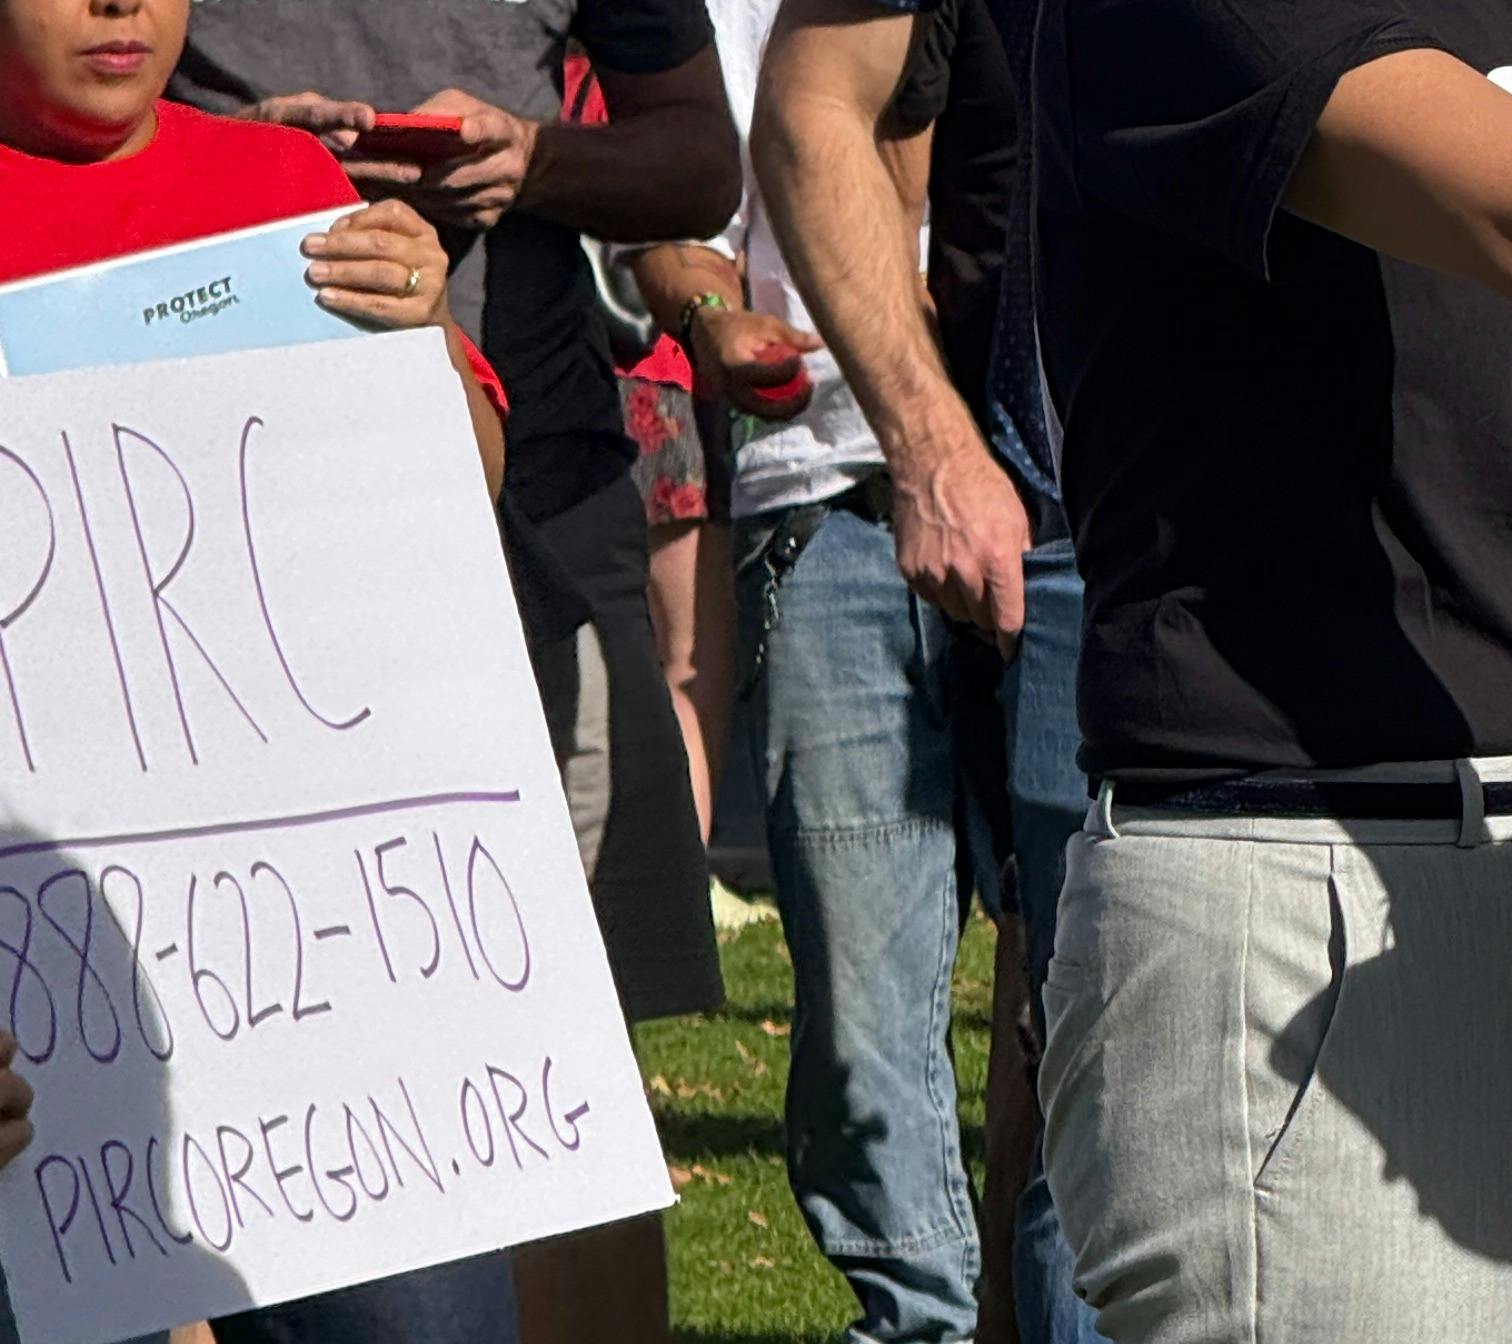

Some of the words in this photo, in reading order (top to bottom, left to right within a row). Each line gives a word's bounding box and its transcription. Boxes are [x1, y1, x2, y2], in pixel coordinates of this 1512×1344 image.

[142, 275, 232, 326] PROTECT
[180, 293, 241, 324] Oregon
[0, 415, 372, 773] PIRC
[34, 1055, 591, 1284] PIRCOREGON.ORG
